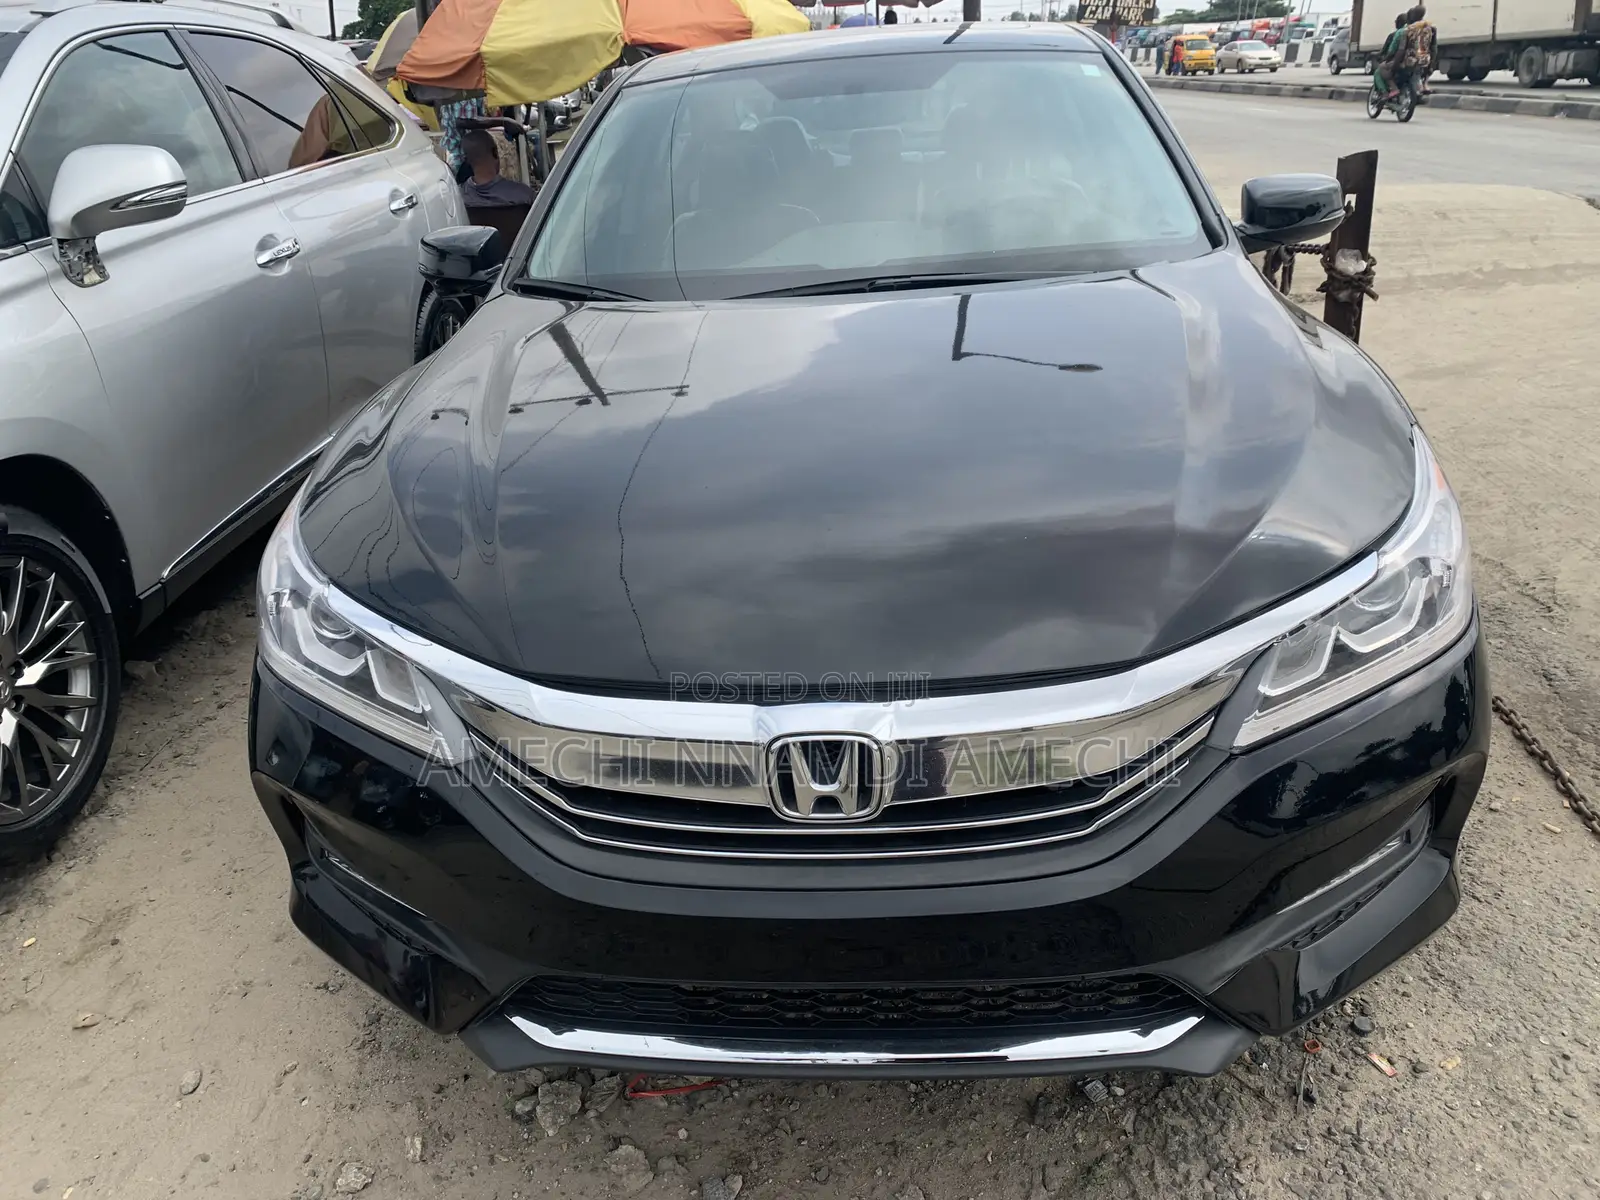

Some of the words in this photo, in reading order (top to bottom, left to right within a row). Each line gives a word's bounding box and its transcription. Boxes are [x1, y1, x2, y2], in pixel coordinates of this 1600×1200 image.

[1084, 6, 1113, 20] CAR
[1115, 7, 1146, 21] PARK
[273, 245, 292, 257] LEXUS
